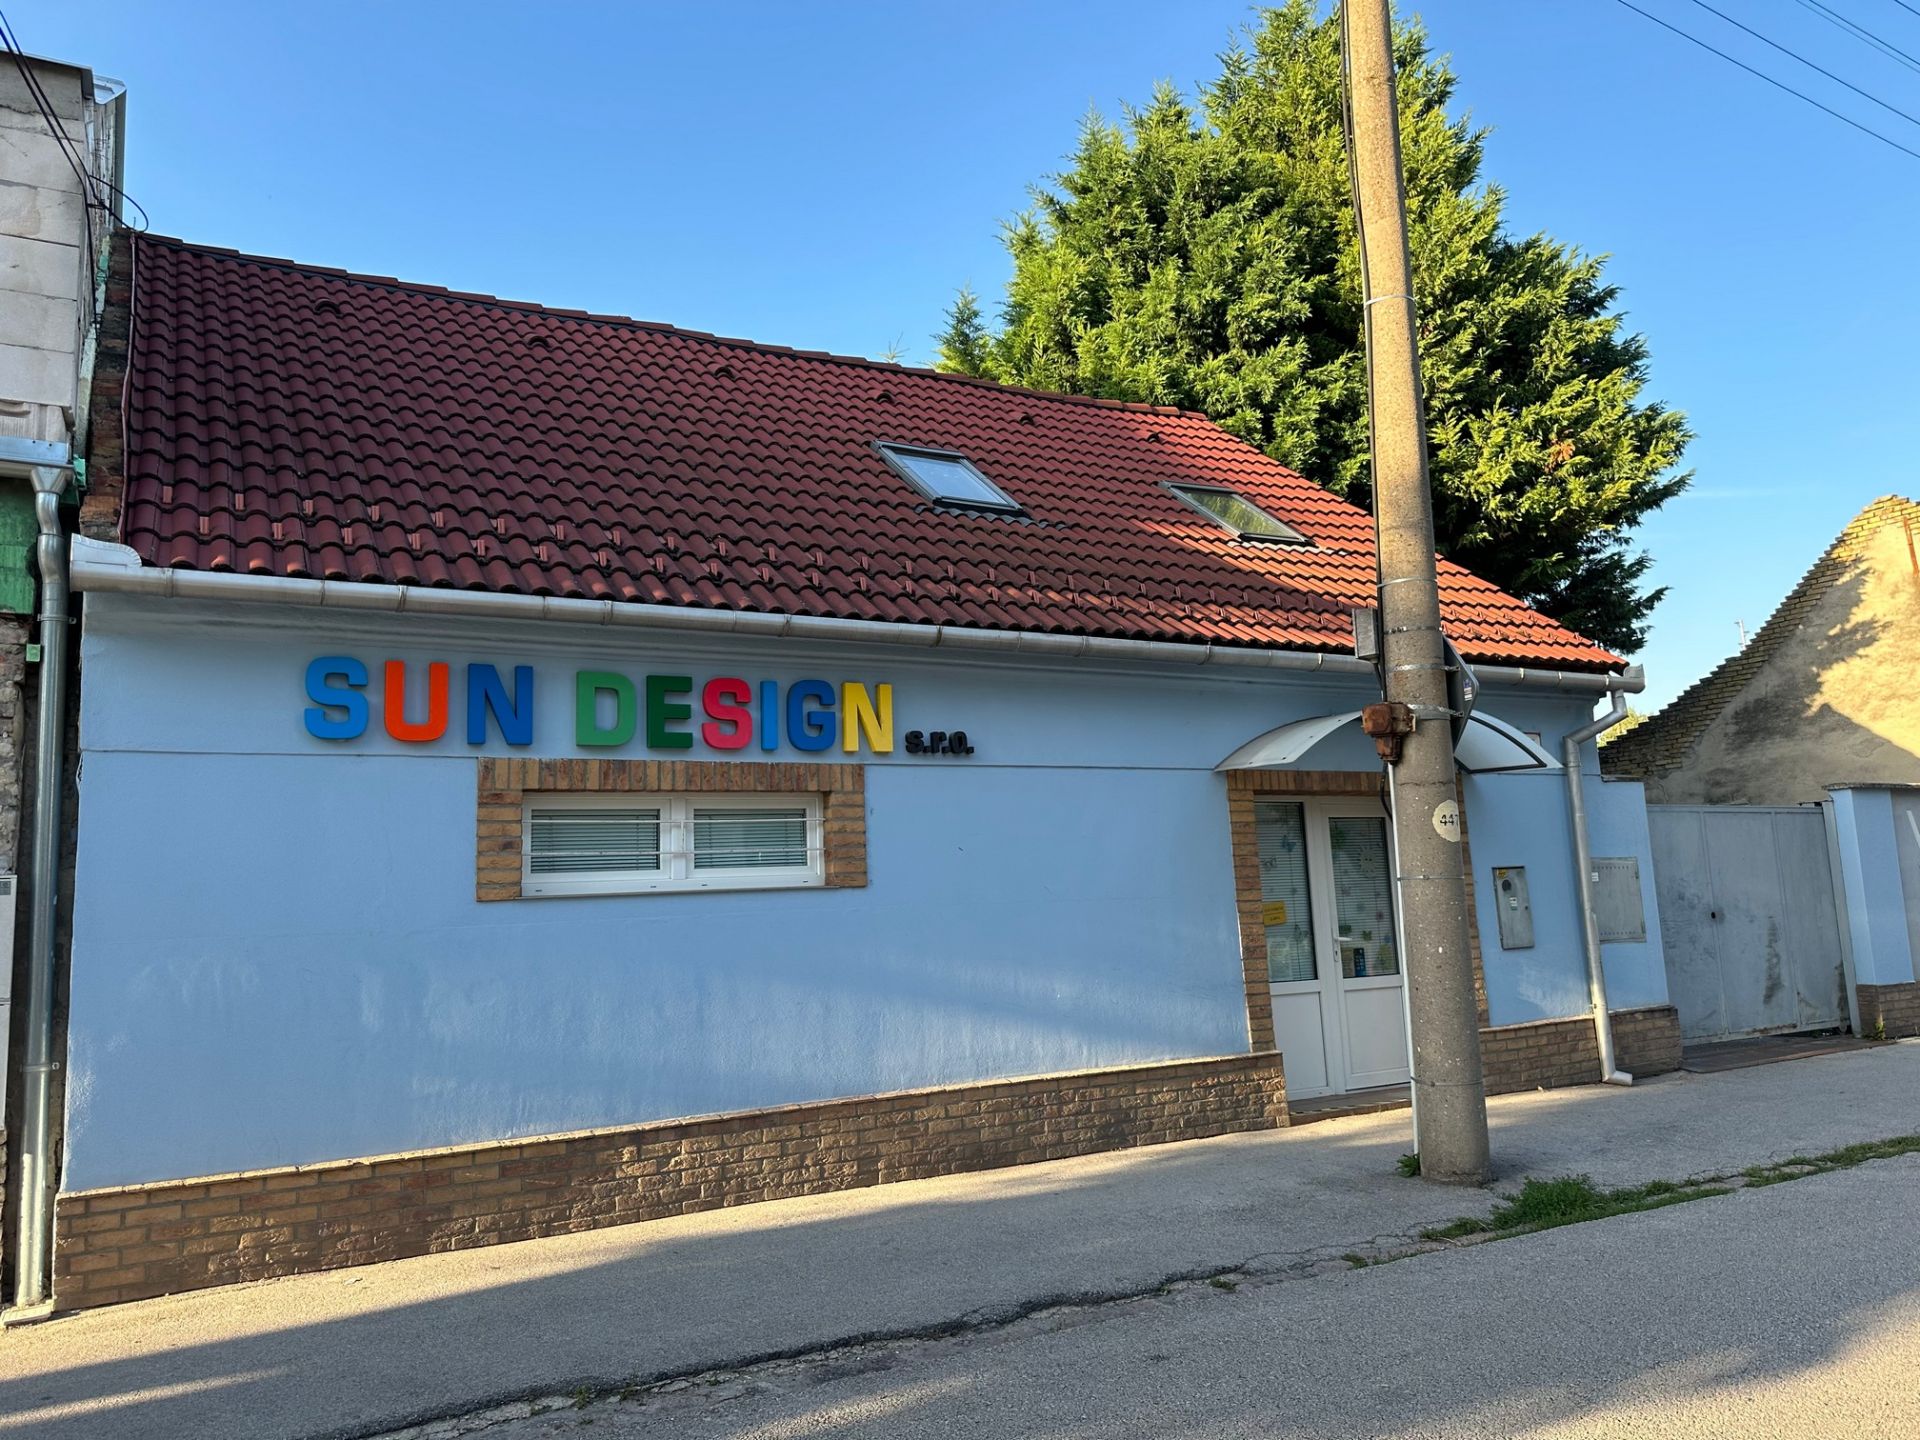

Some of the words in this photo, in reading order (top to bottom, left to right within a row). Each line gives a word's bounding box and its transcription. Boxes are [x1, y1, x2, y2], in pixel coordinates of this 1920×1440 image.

[304, 656, 534, 746] SUN
[575, 670, 894, 753] DESIGN
[904, 730, 975, 754] s.r.o.
